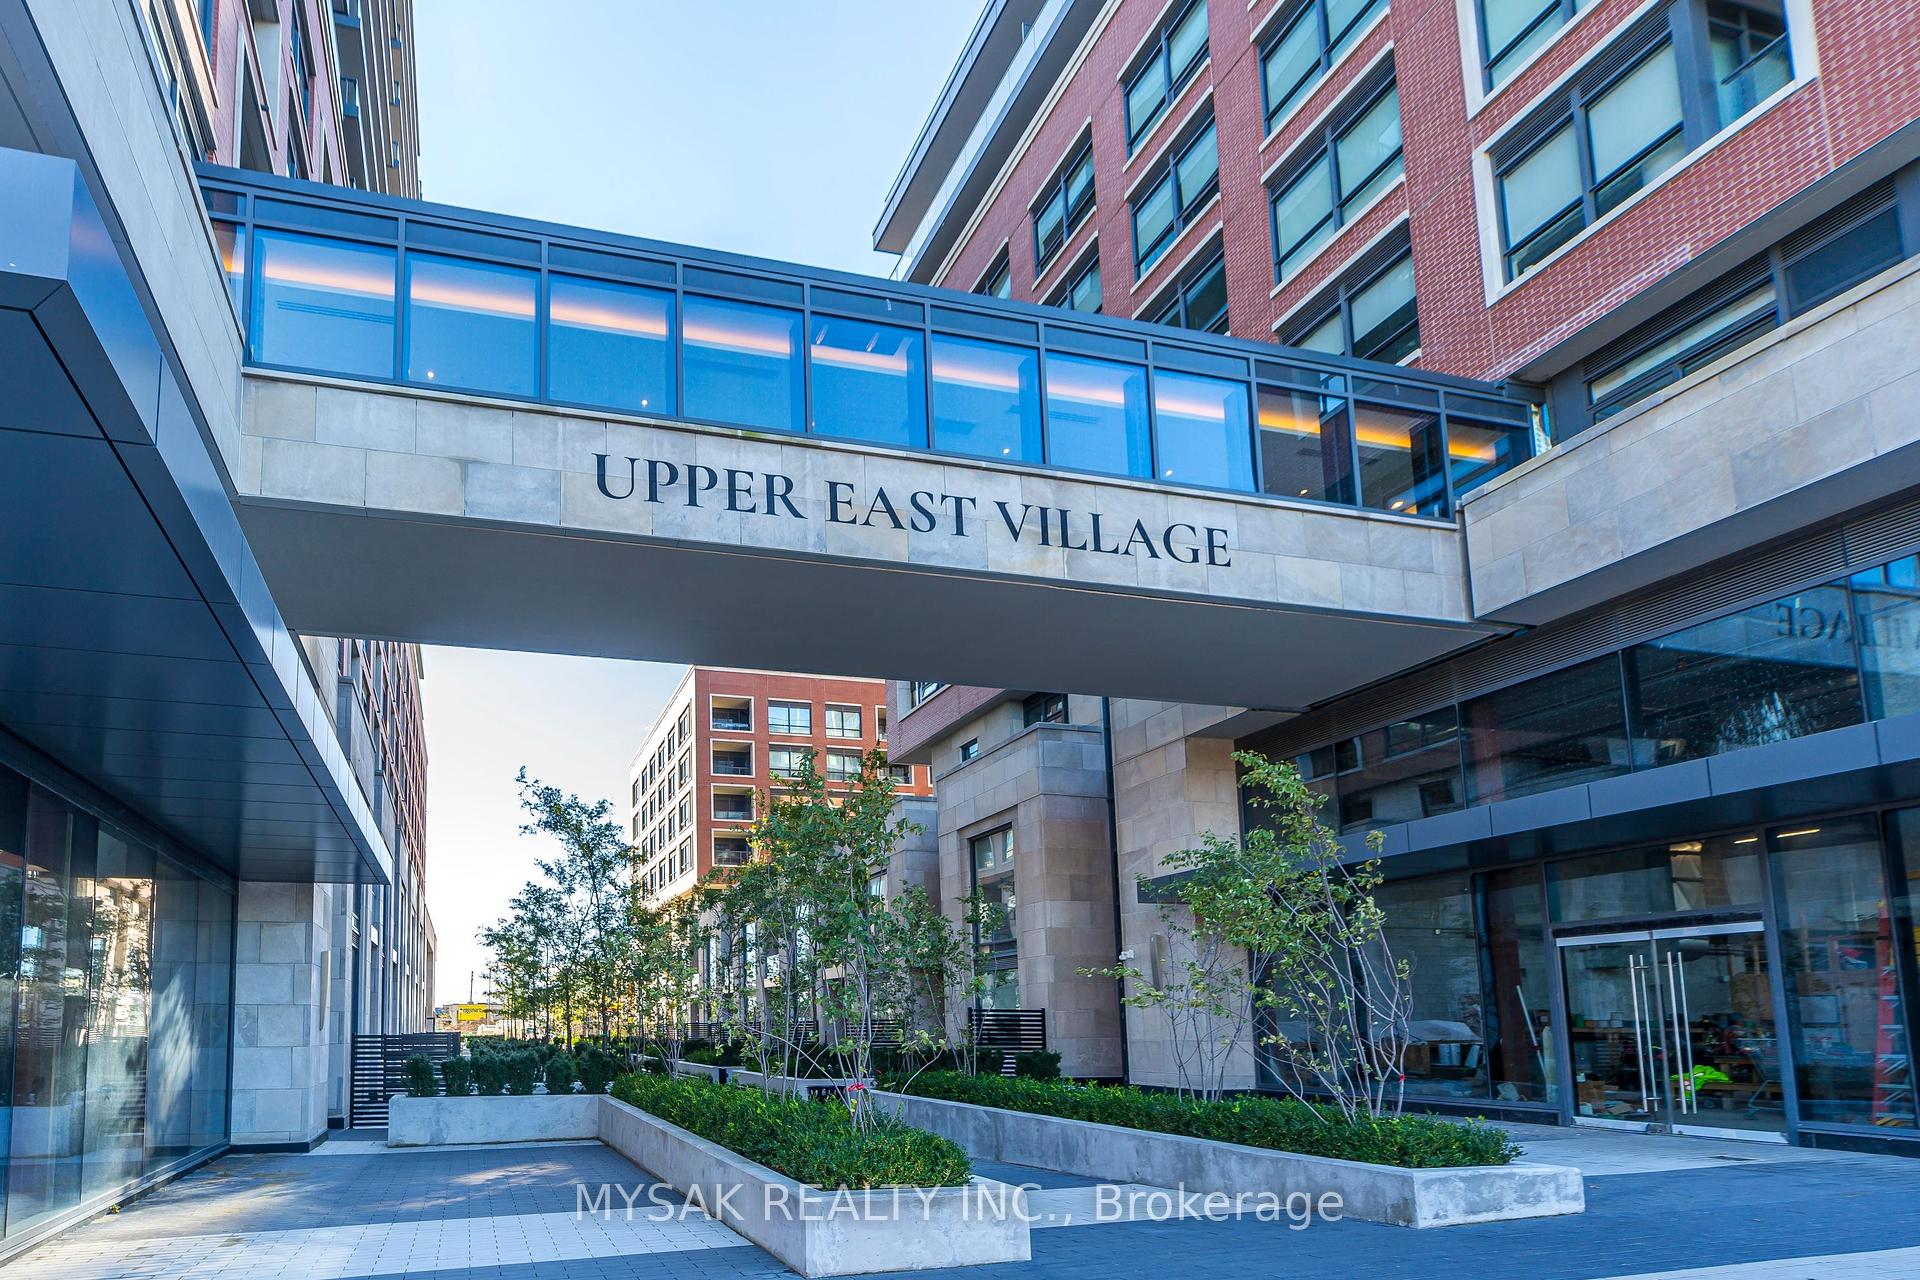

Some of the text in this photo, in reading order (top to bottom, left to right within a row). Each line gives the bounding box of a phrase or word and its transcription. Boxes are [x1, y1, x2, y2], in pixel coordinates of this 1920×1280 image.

[592, 453, 1232, 568] UPPER EAST VILLAGE
